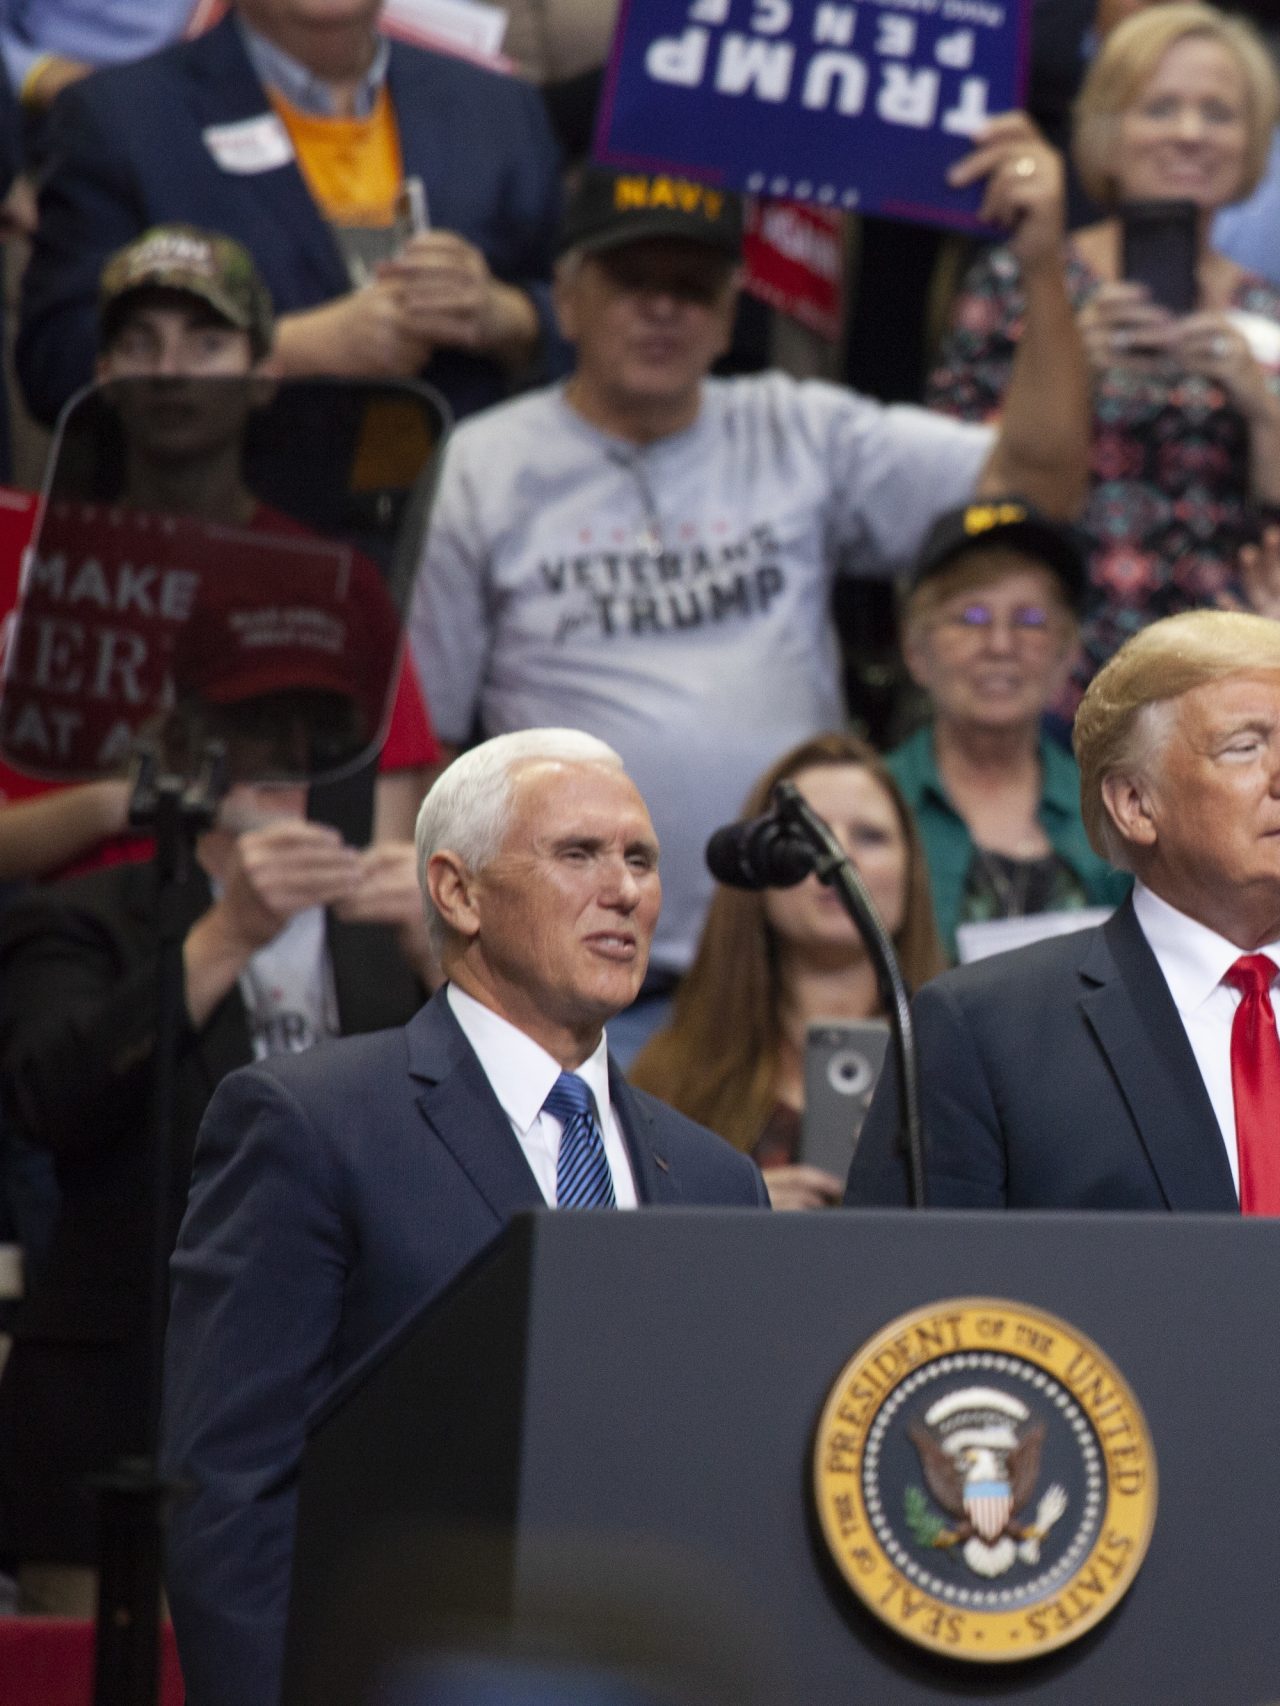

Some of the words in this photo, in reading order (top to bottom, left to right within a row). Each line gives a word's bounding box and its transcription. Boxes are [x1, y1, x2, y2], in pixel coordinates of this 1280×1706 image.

[644, 26, 990, 137] TRUMP
[596, 562, 786, 637] TRUMP
[825, 1314, 964, 1476] PRESIDENT
[1064, 1350, 1142, 1498] UNITED
[880, 1570, 966, 1645] SEAL
[1024, 1530, 1132, 1642] STATES
